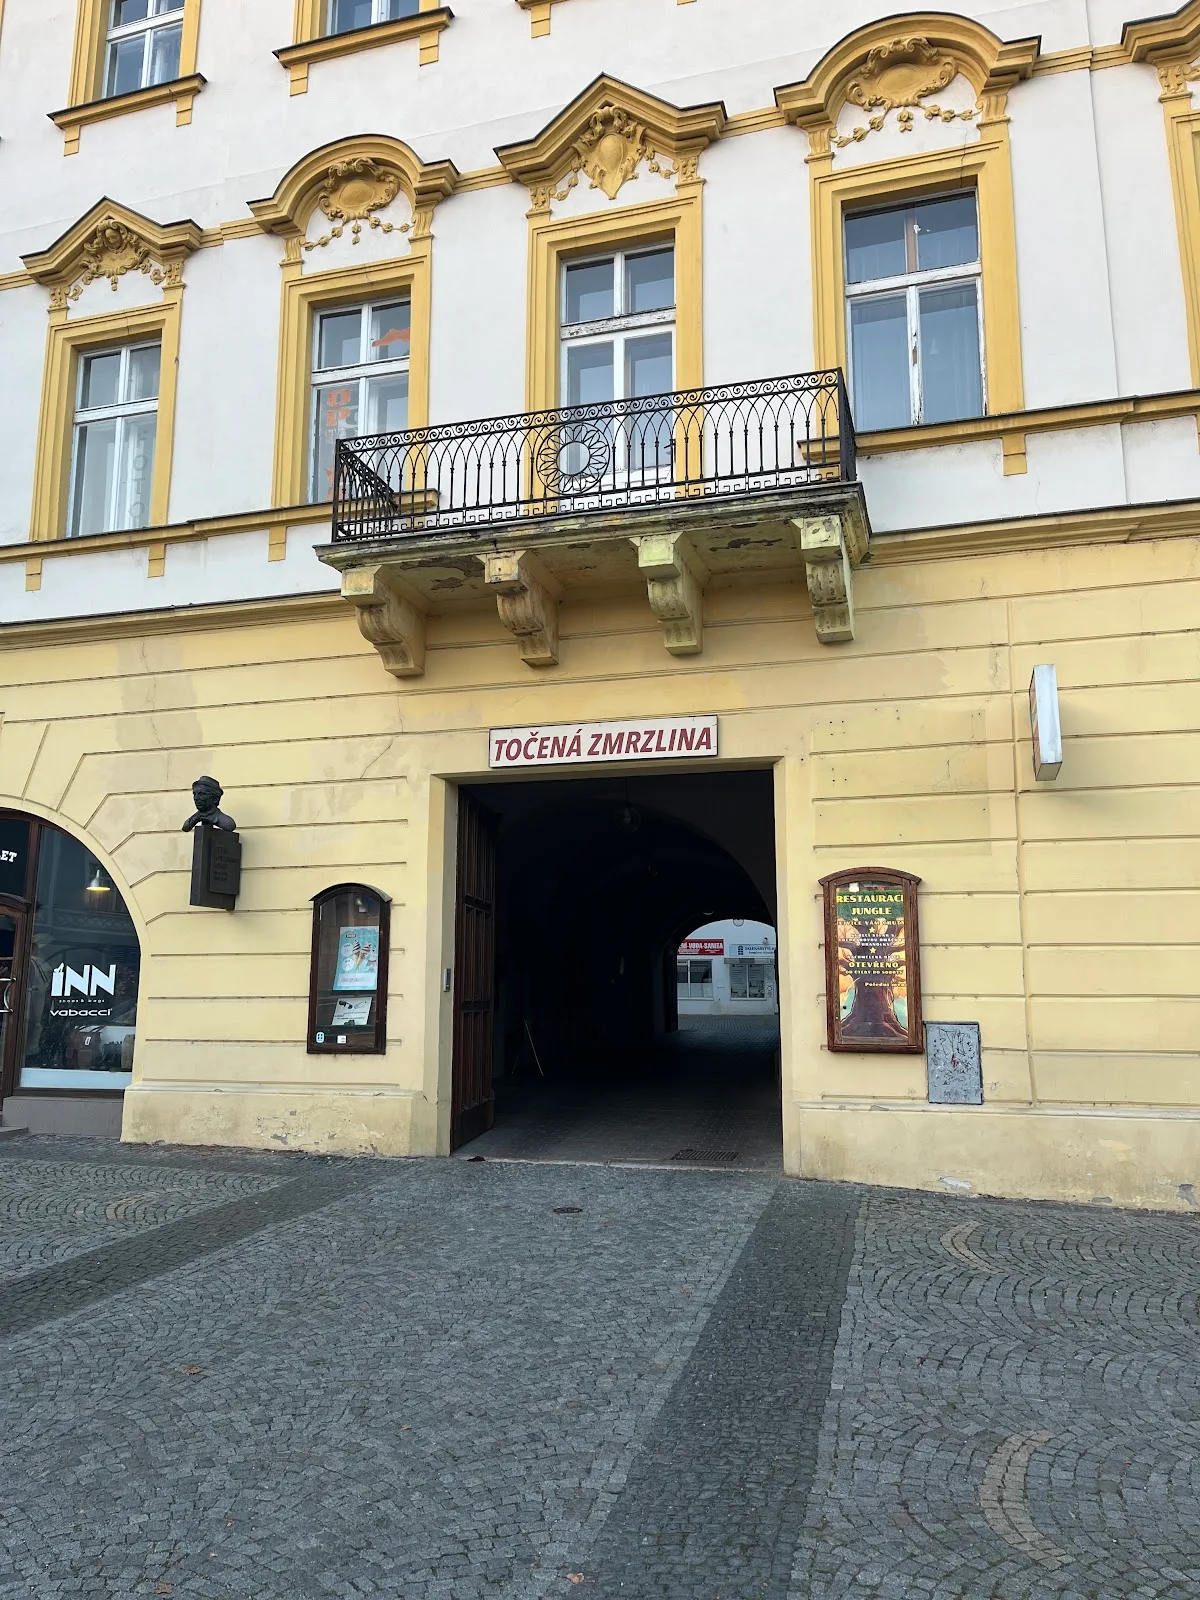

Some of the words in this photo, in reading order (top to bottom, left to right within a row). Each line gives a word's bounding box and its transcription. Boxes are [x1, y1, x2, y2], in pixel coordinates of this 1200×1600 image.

[494, 728, 582, 761] TOČENÁ
[587, 726, 712, 756] ZMRZLINA
[0, 849, 18, 863] ET
[851, 907, 892, 915] JUNGLE
[848, 960, 899, 968] OTEVŘENO
[50, 1008, 112, 1017] vabacci
